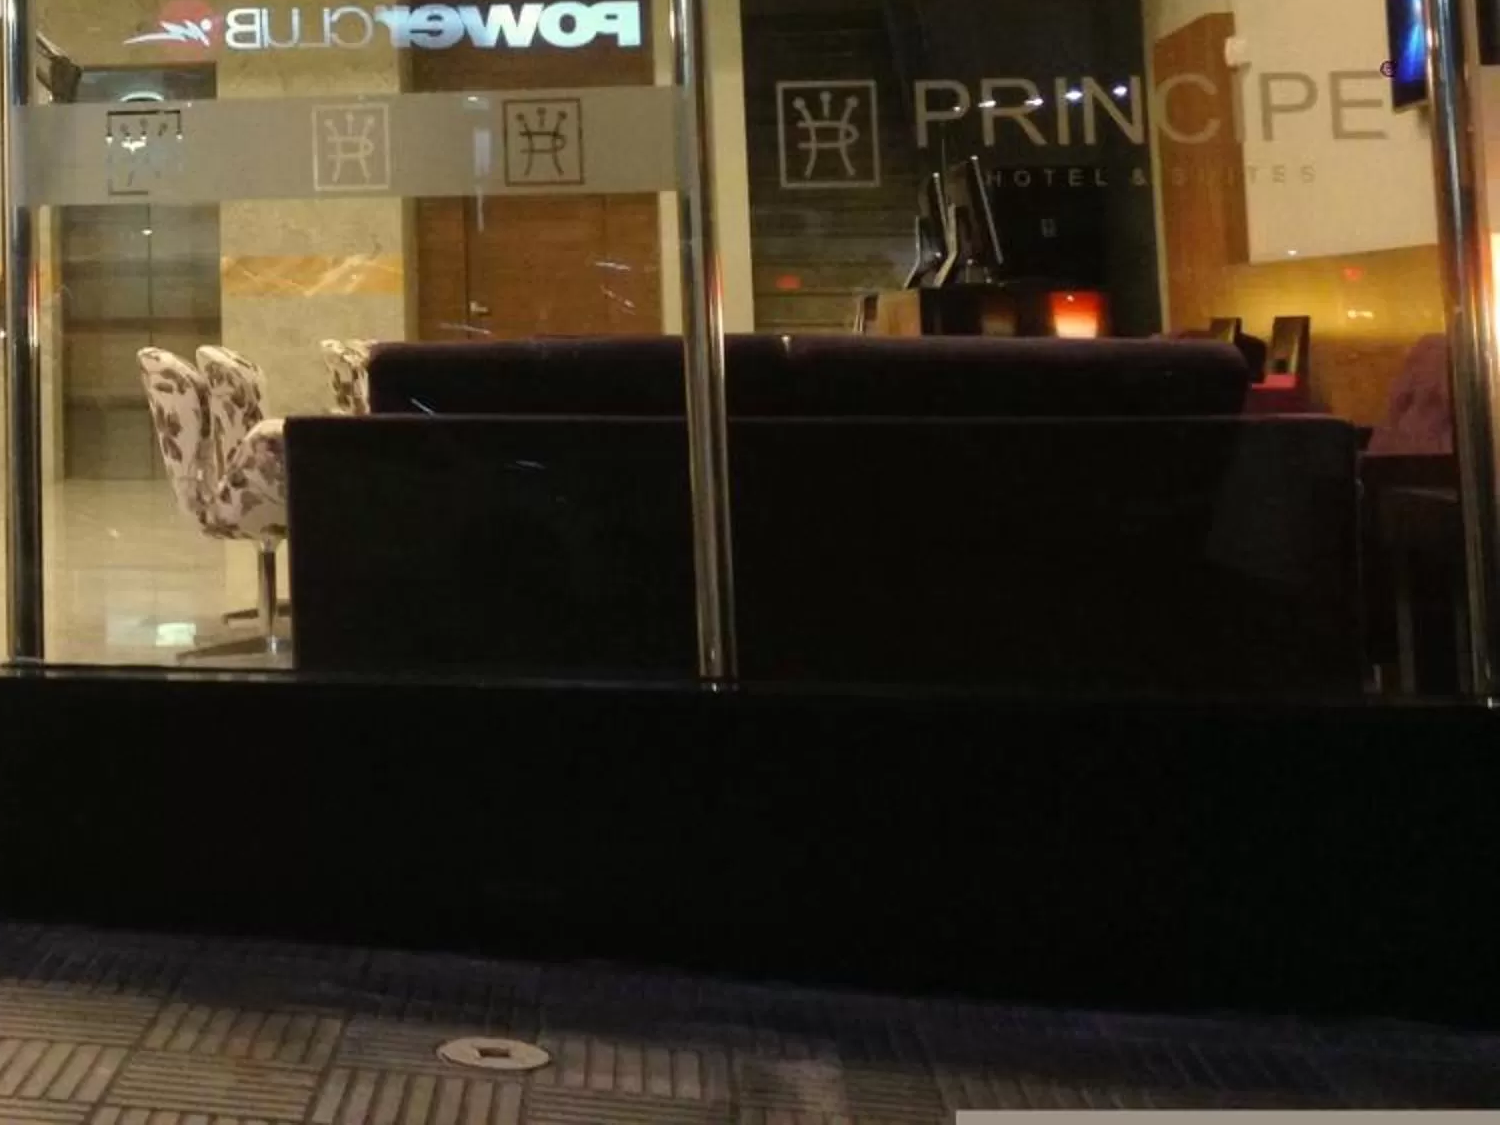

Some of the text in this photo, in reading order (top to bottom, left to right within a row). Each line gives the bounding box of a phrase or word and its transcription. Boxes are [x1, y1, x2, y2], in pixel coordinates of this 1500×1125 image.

[912, 69, 1389, 149] PRINCIPE
[984, 164, 1108, 189] HOTEL
[1130, 167, 1149, 187] &
